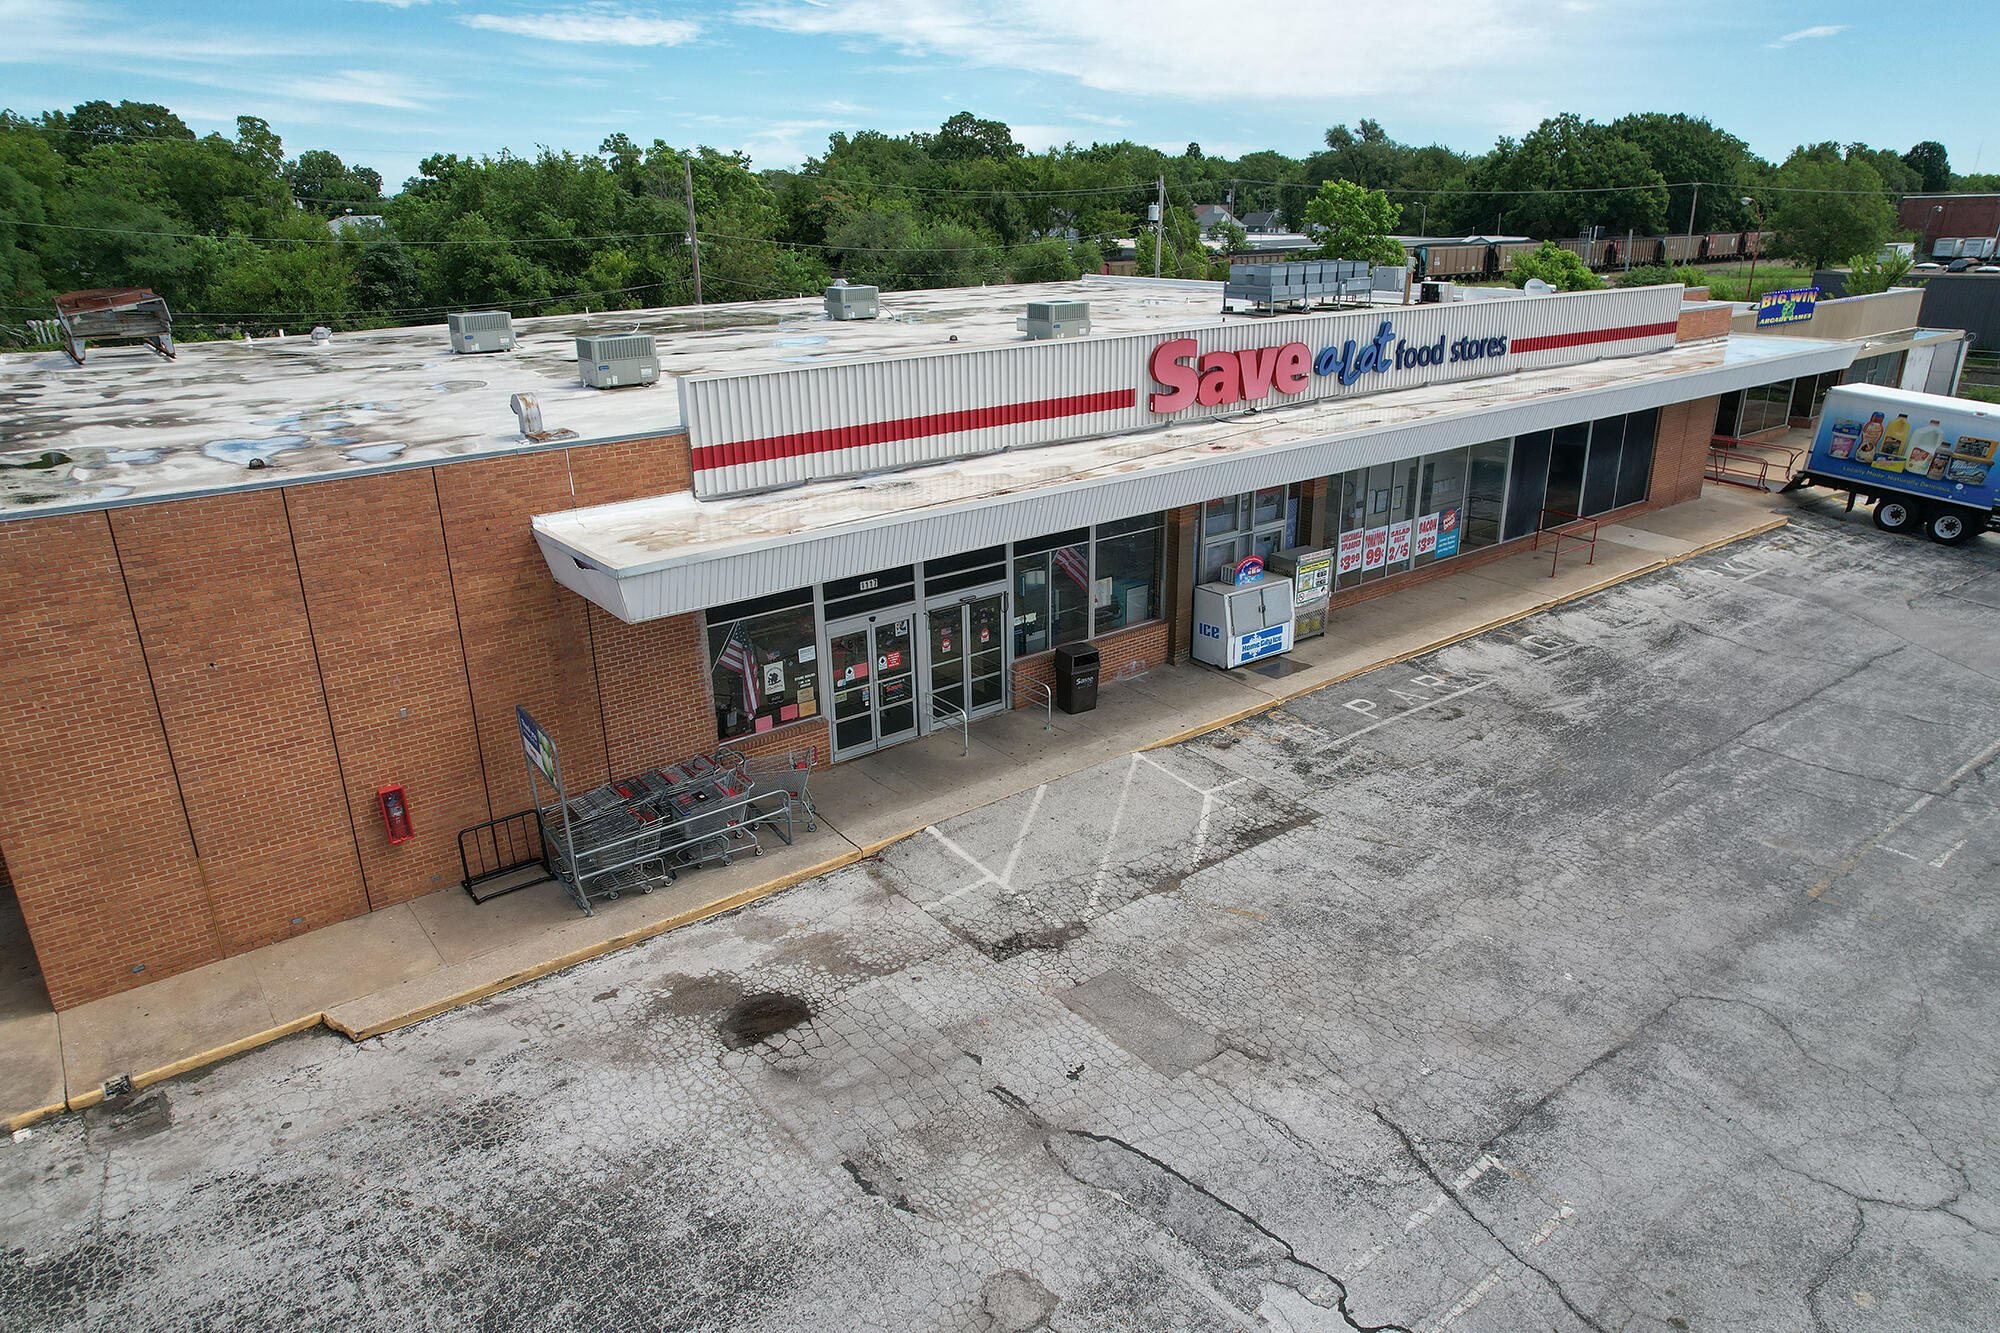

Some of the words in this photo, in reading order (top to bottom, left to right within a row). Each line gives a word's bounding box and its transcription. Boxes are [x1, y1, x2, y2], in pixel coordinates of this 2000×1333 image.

[1761, 294, 1787, 309] BIG
[1790, 291, 1817, 304] WIN
[1149, 338, 1311, 414] Save
[1395, 334, 1446, 370] food
[1449, 334, 1508, 361] stores
[1391, 528, 1410, 537] SALAD
[1418, 518, 1437, 534] BACON
[1241, 642, 1260, 652] Home
[1260, 638, 1273, 647] City
